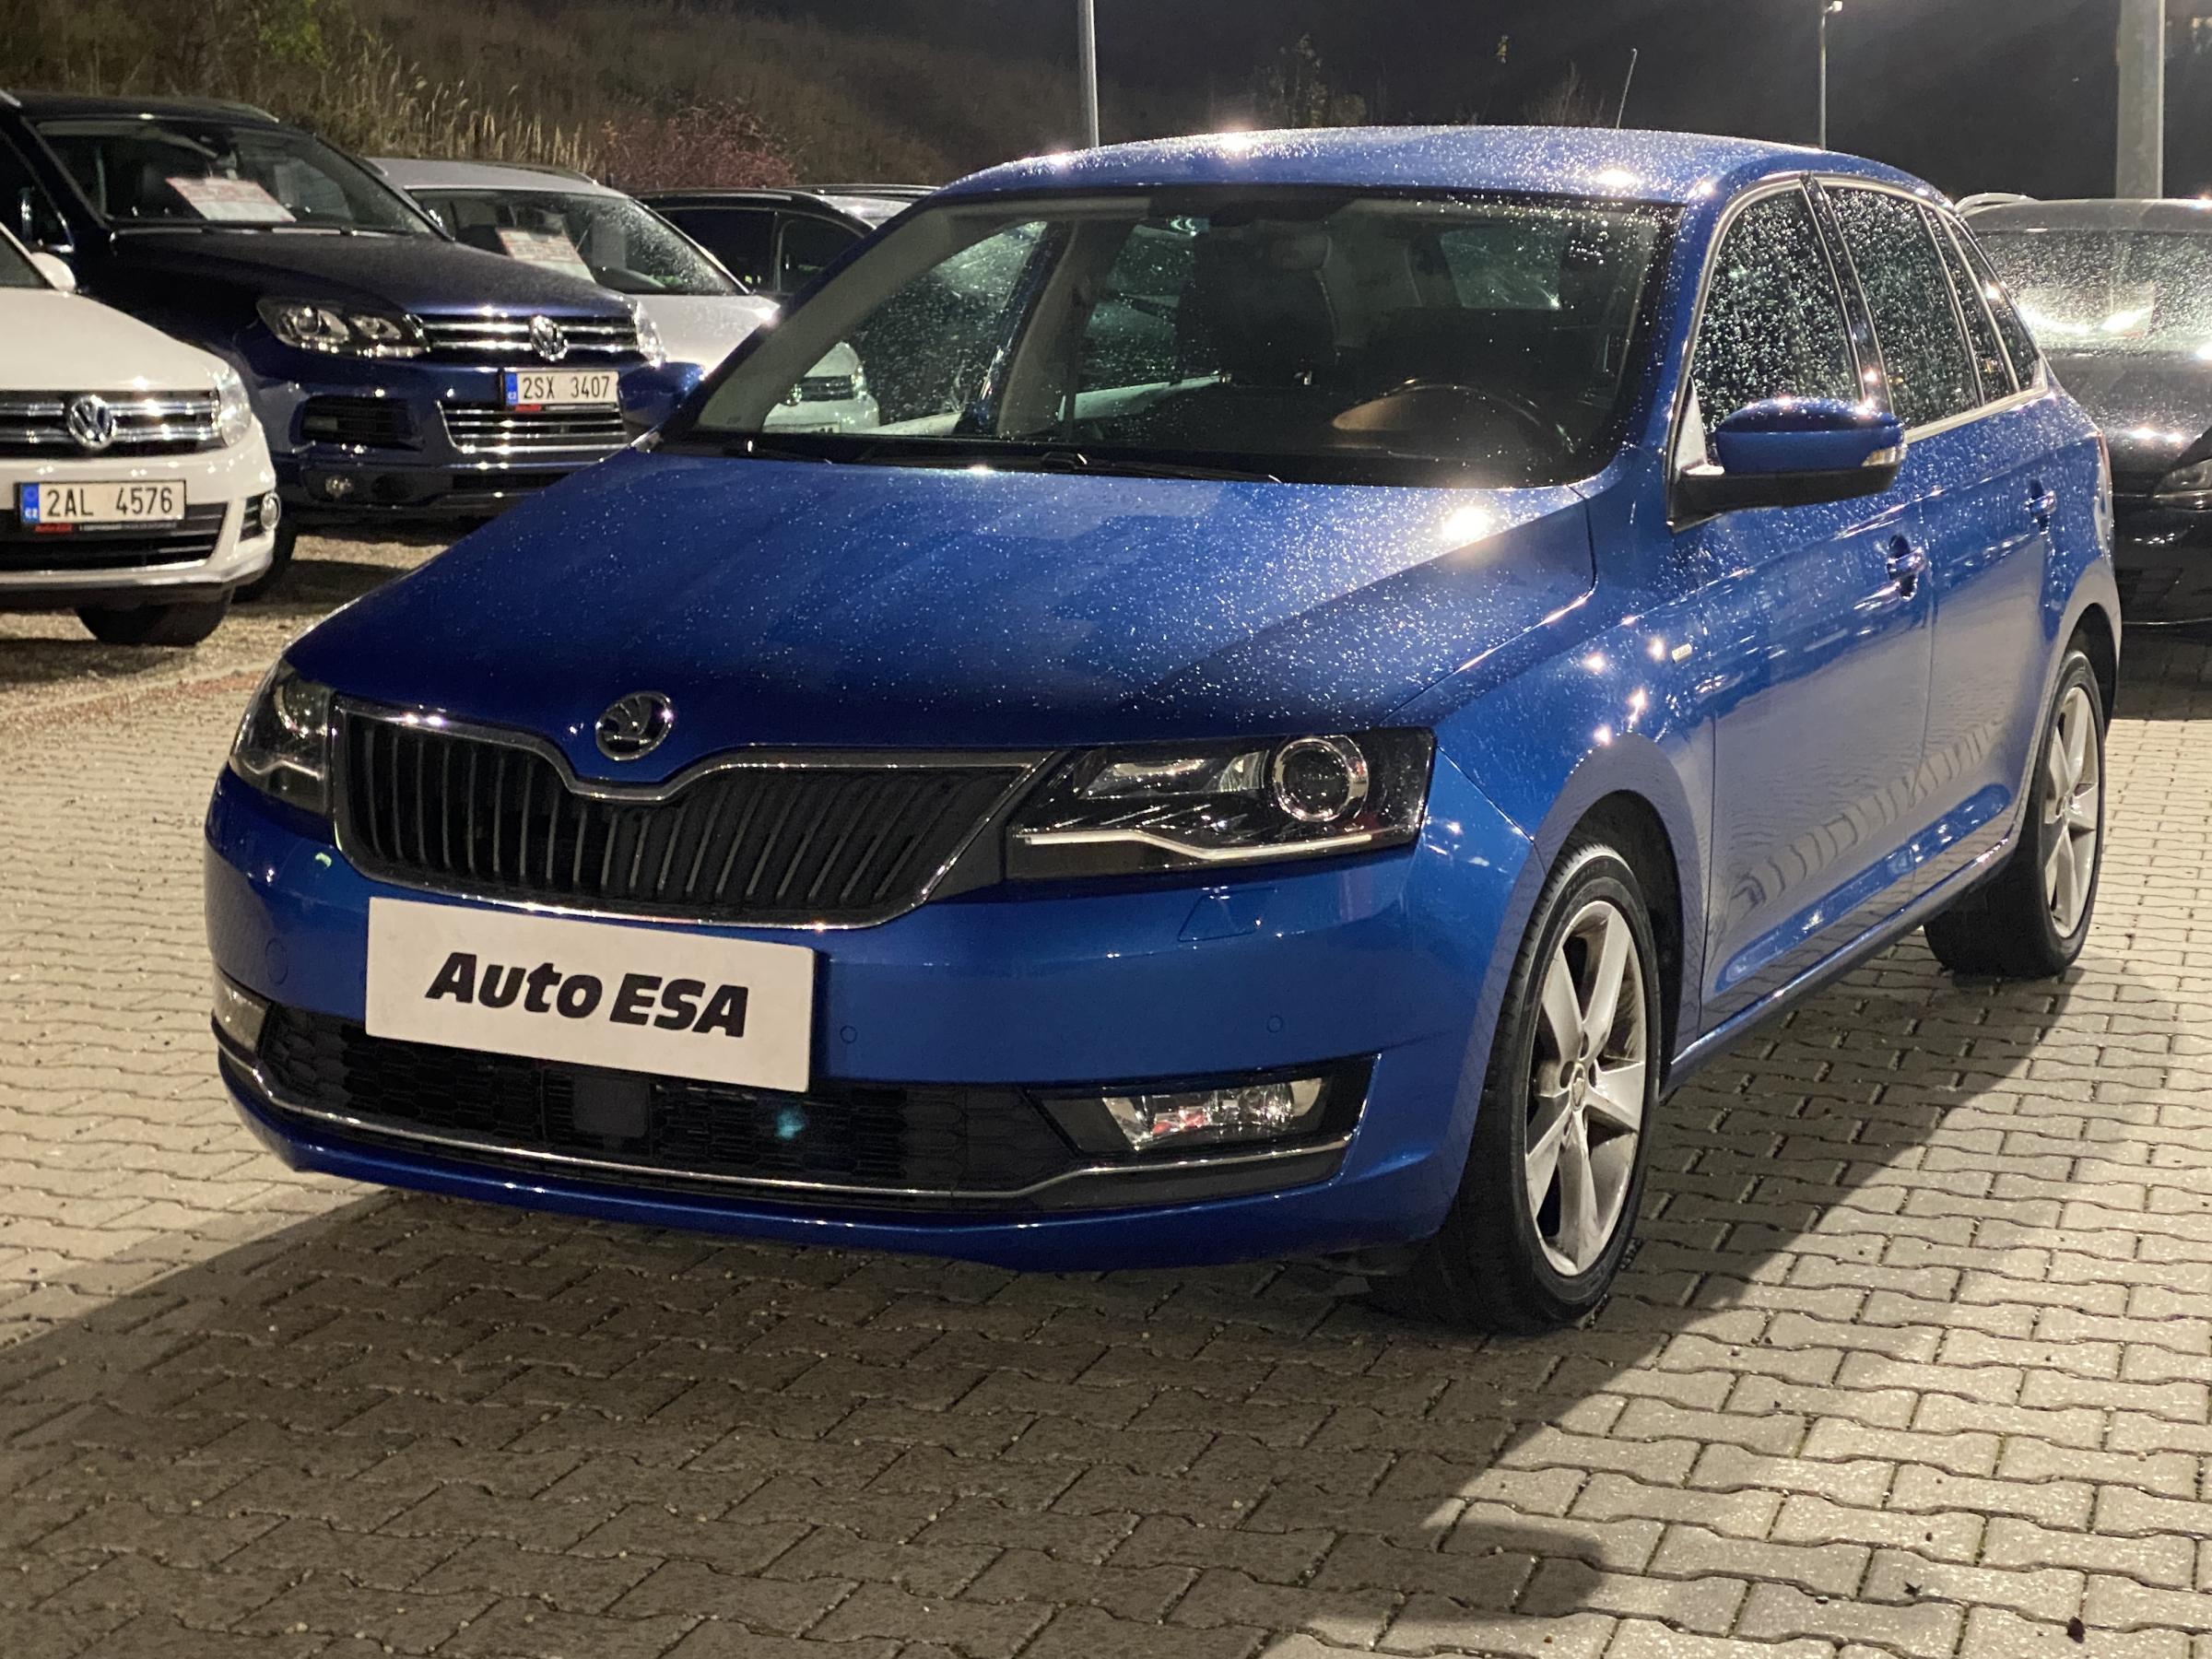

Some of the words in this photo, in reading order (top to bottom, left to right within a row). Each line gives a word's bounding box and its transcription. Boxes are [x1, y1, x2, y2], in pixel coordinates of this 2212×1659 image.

[523, 376, 555, 399] 2SX
[571, 375, 610, 398] 3407
[47, 489, 94, 517] 2AL
[115, 487, 173, 514] 4576
[425, 952, 604, 1018] Auto
[609, 973, 748, 1038] ESA
